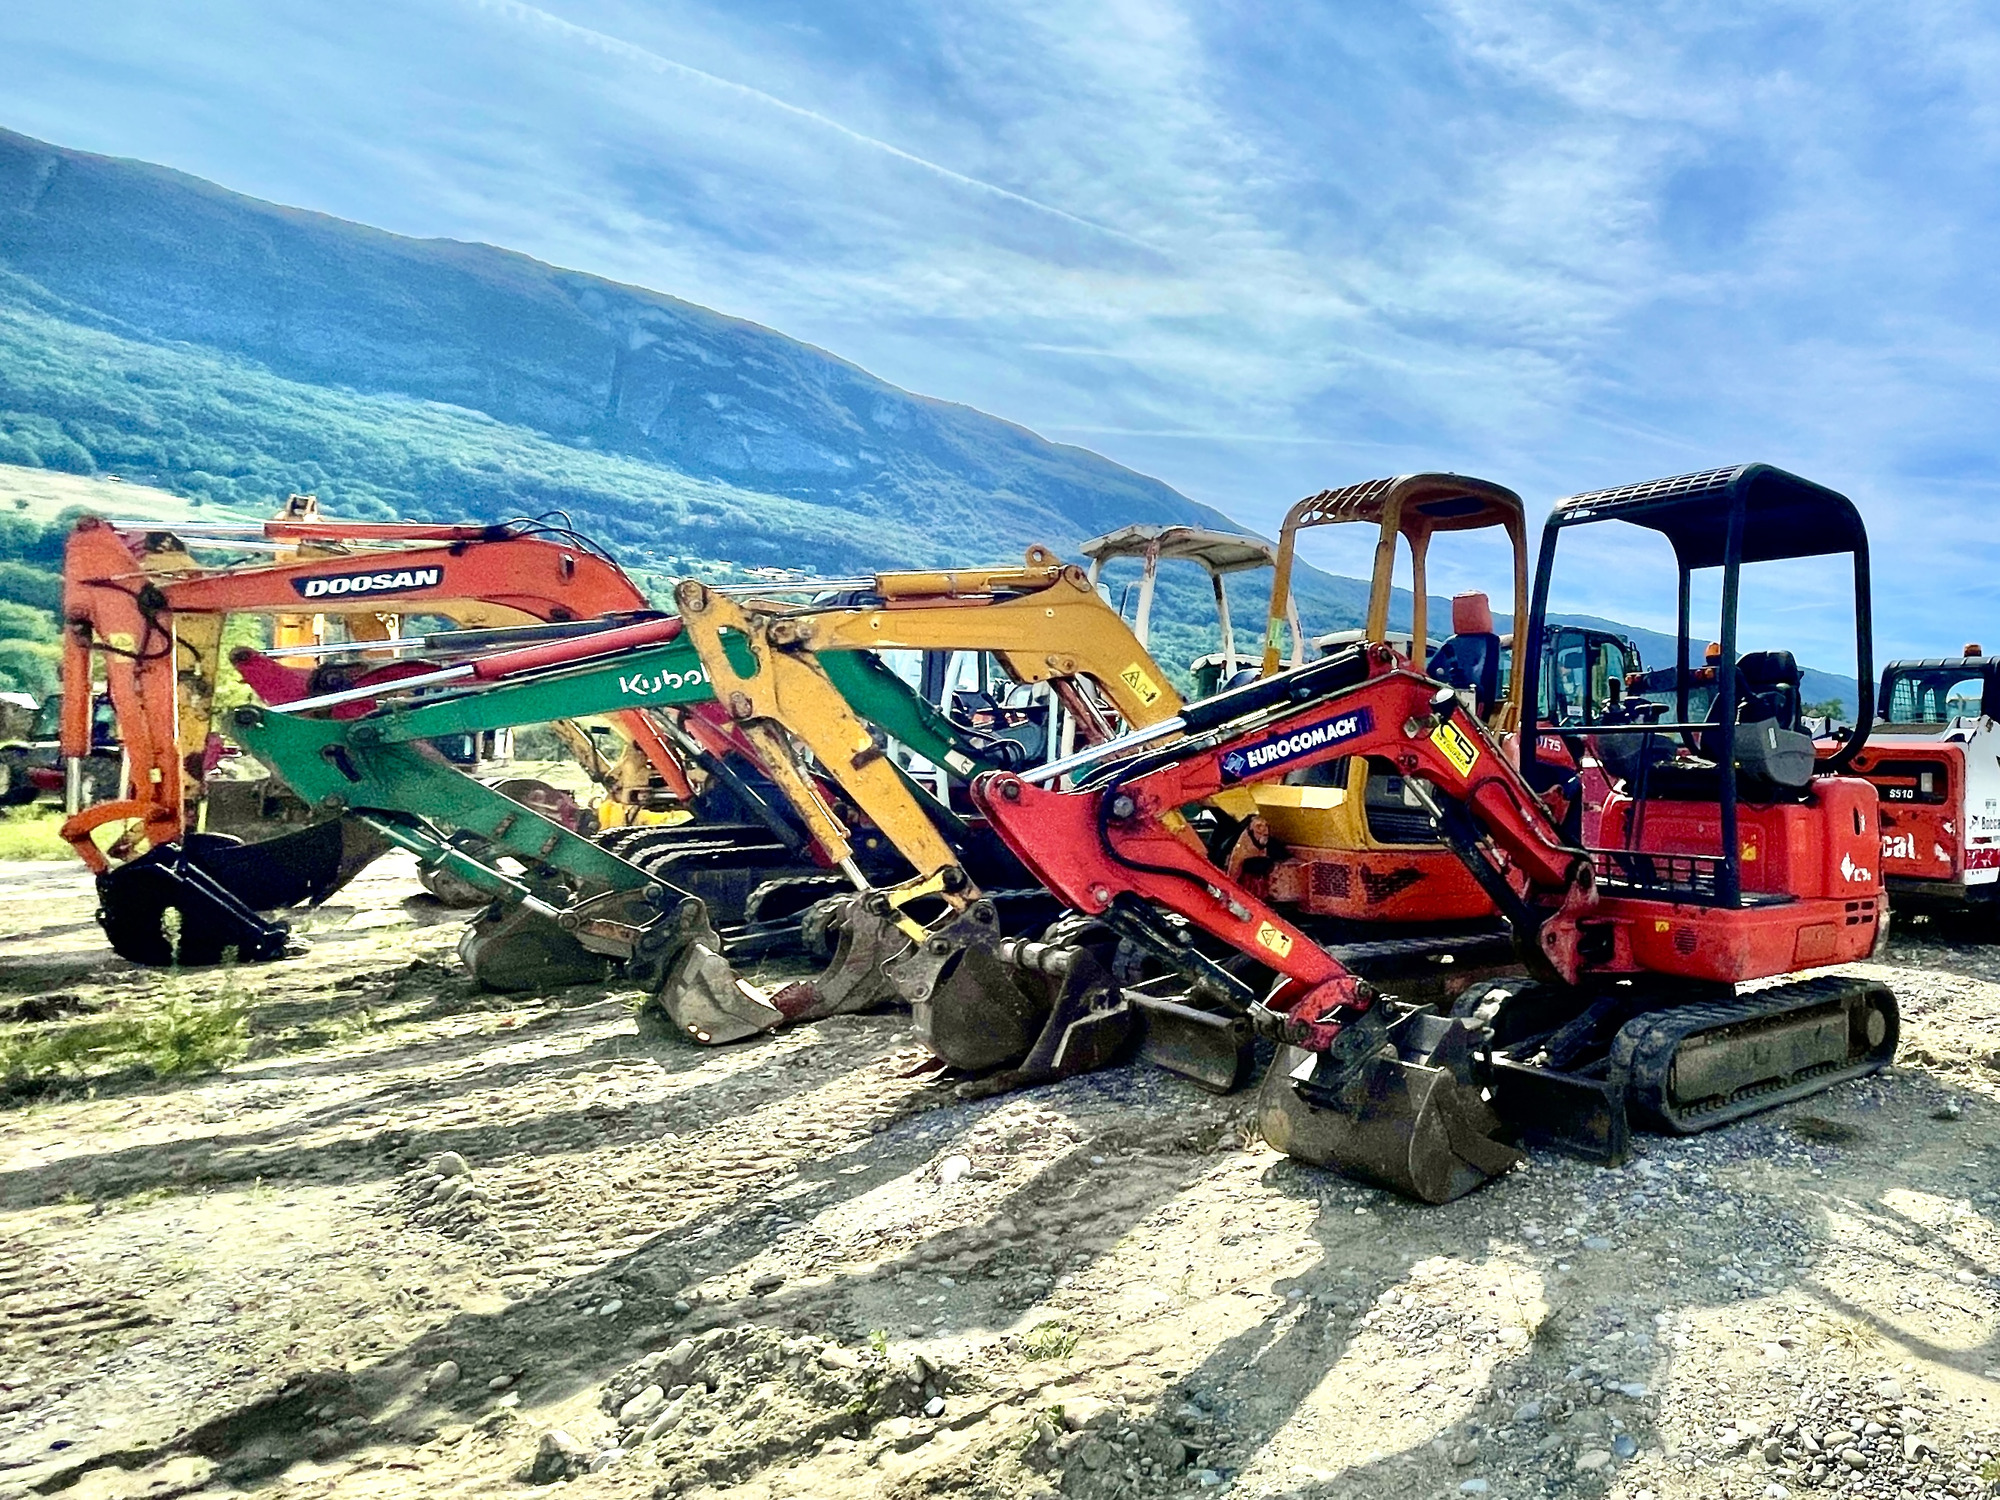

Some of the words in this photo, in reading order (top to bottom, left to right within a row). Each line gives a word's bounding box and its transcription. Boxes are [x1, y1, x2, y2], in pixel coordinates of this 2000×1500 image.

[304, 569, 438, 597] DOOSAN
[618, 662, 711, 695] Kubo
[1246, 717, 1357, 768] EUROCOMACH
[1889, 788, 1914, 799] S510
